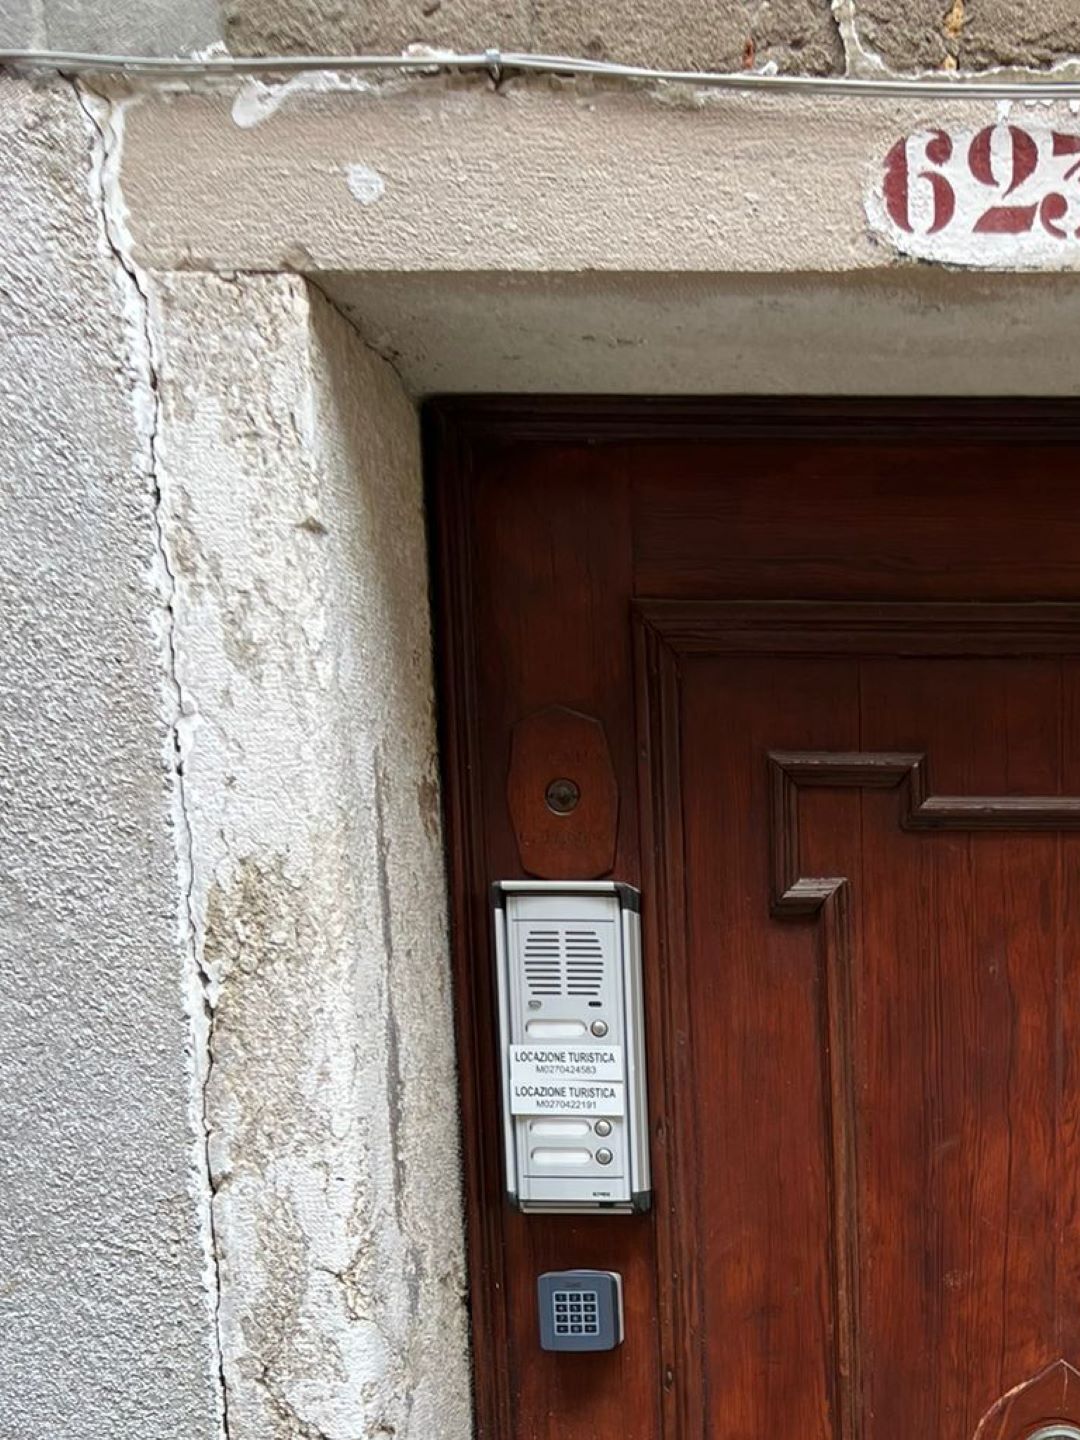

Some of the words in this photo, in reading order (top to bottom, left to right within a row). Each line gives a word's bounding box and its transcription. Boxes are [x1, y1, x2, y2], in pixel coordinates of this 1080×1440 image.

[515, 1051, 566, 1063] LOCAZIONE
[568, 1052, 616, 1063] TURISTICA
[515, 1086, 567, 1097] LOCAZIONE
[569, 1087, 616, 1099] TURISTICA
